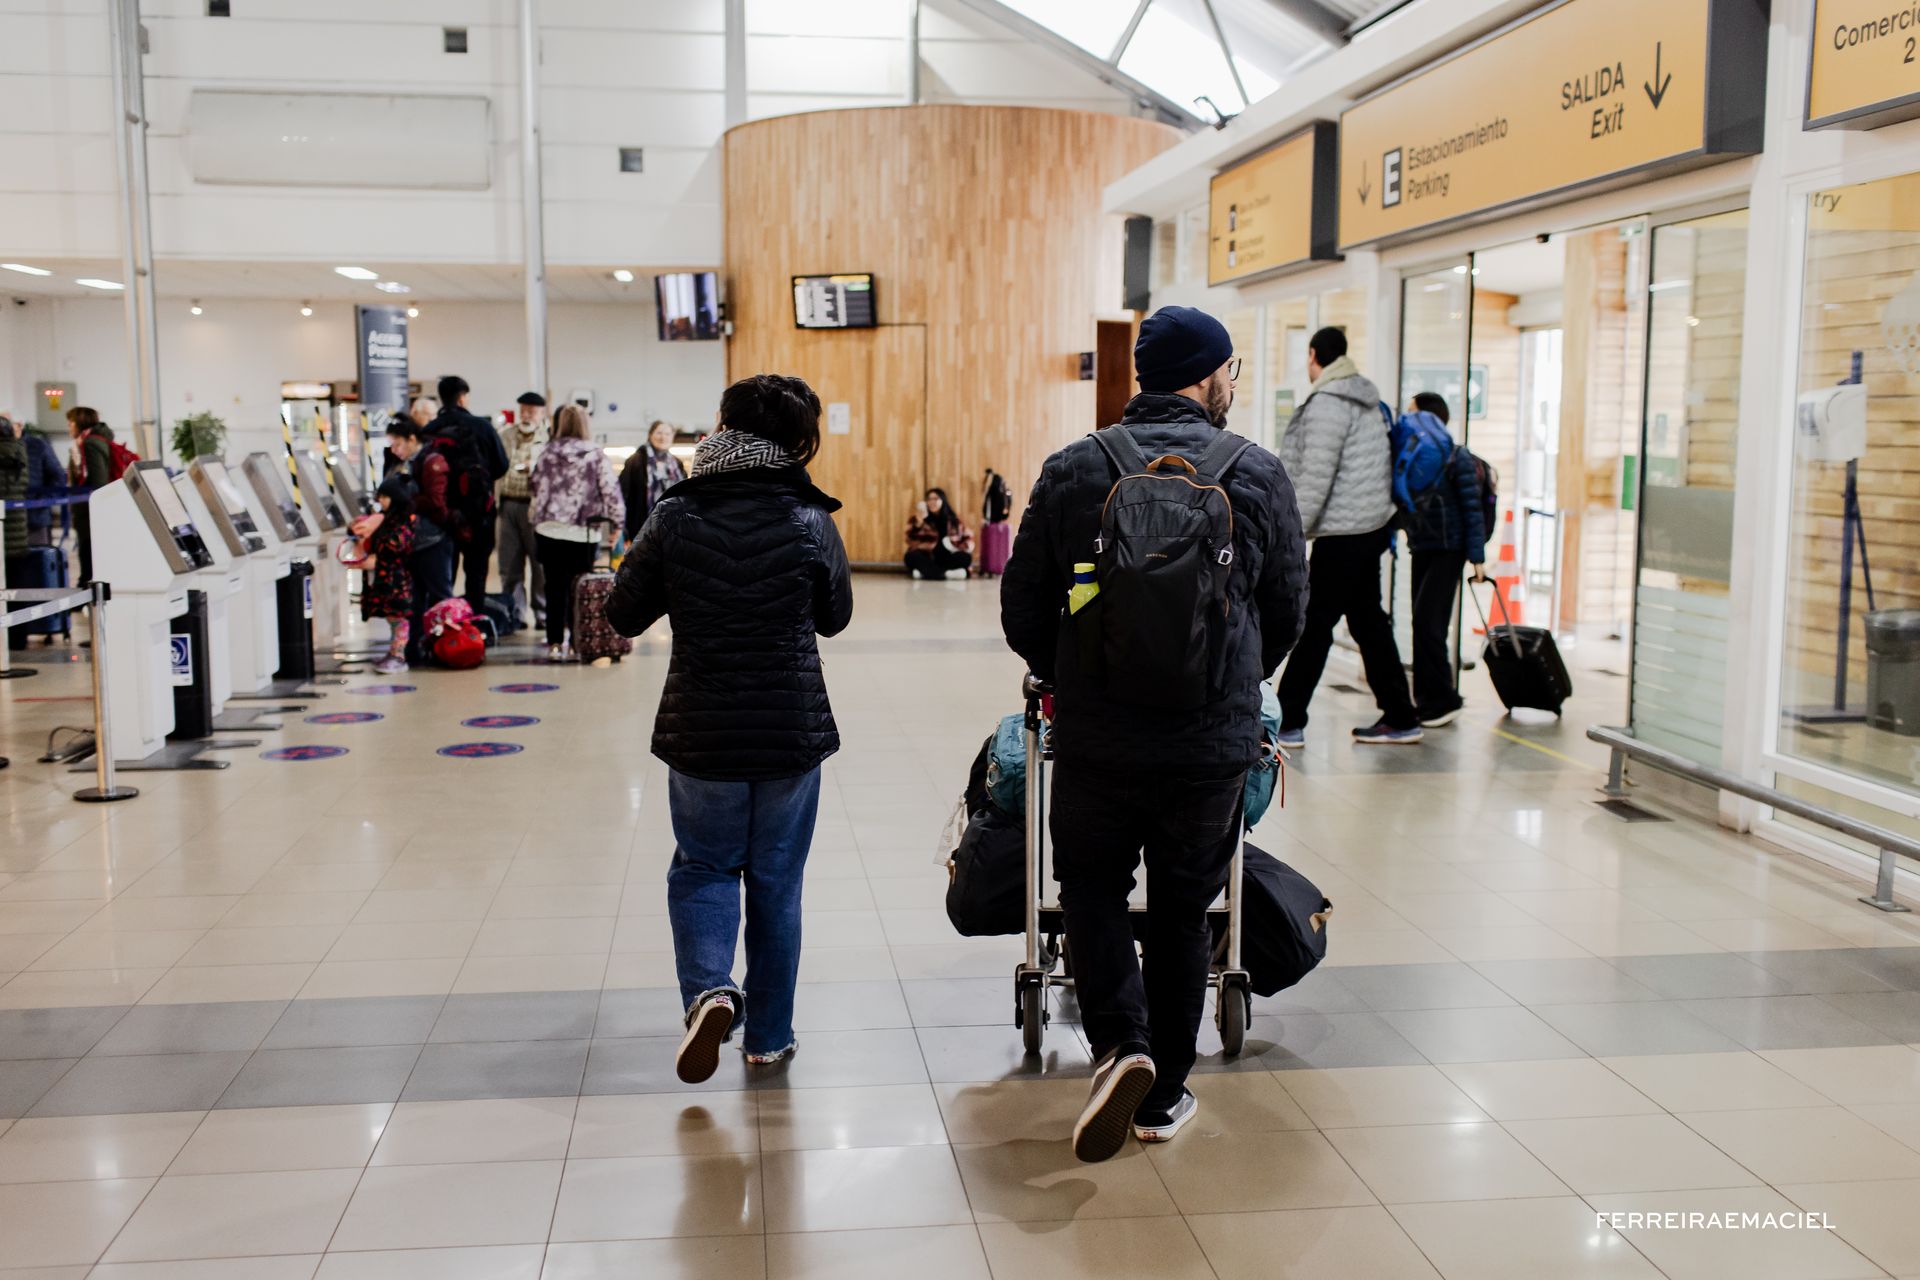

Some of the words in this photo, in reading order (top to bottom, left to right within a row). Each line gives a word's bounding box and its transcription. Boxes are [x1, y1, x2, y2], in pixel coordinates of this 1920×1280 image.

[1561, 61, 1625, 110] SALIDA
[1408, 117, 1508, 170] Estacionamiento
[1591, 102, 1625, 139] Exit
[1383, 150, 1401, 206] E
[1408, 171, 1450, 200] Parking
